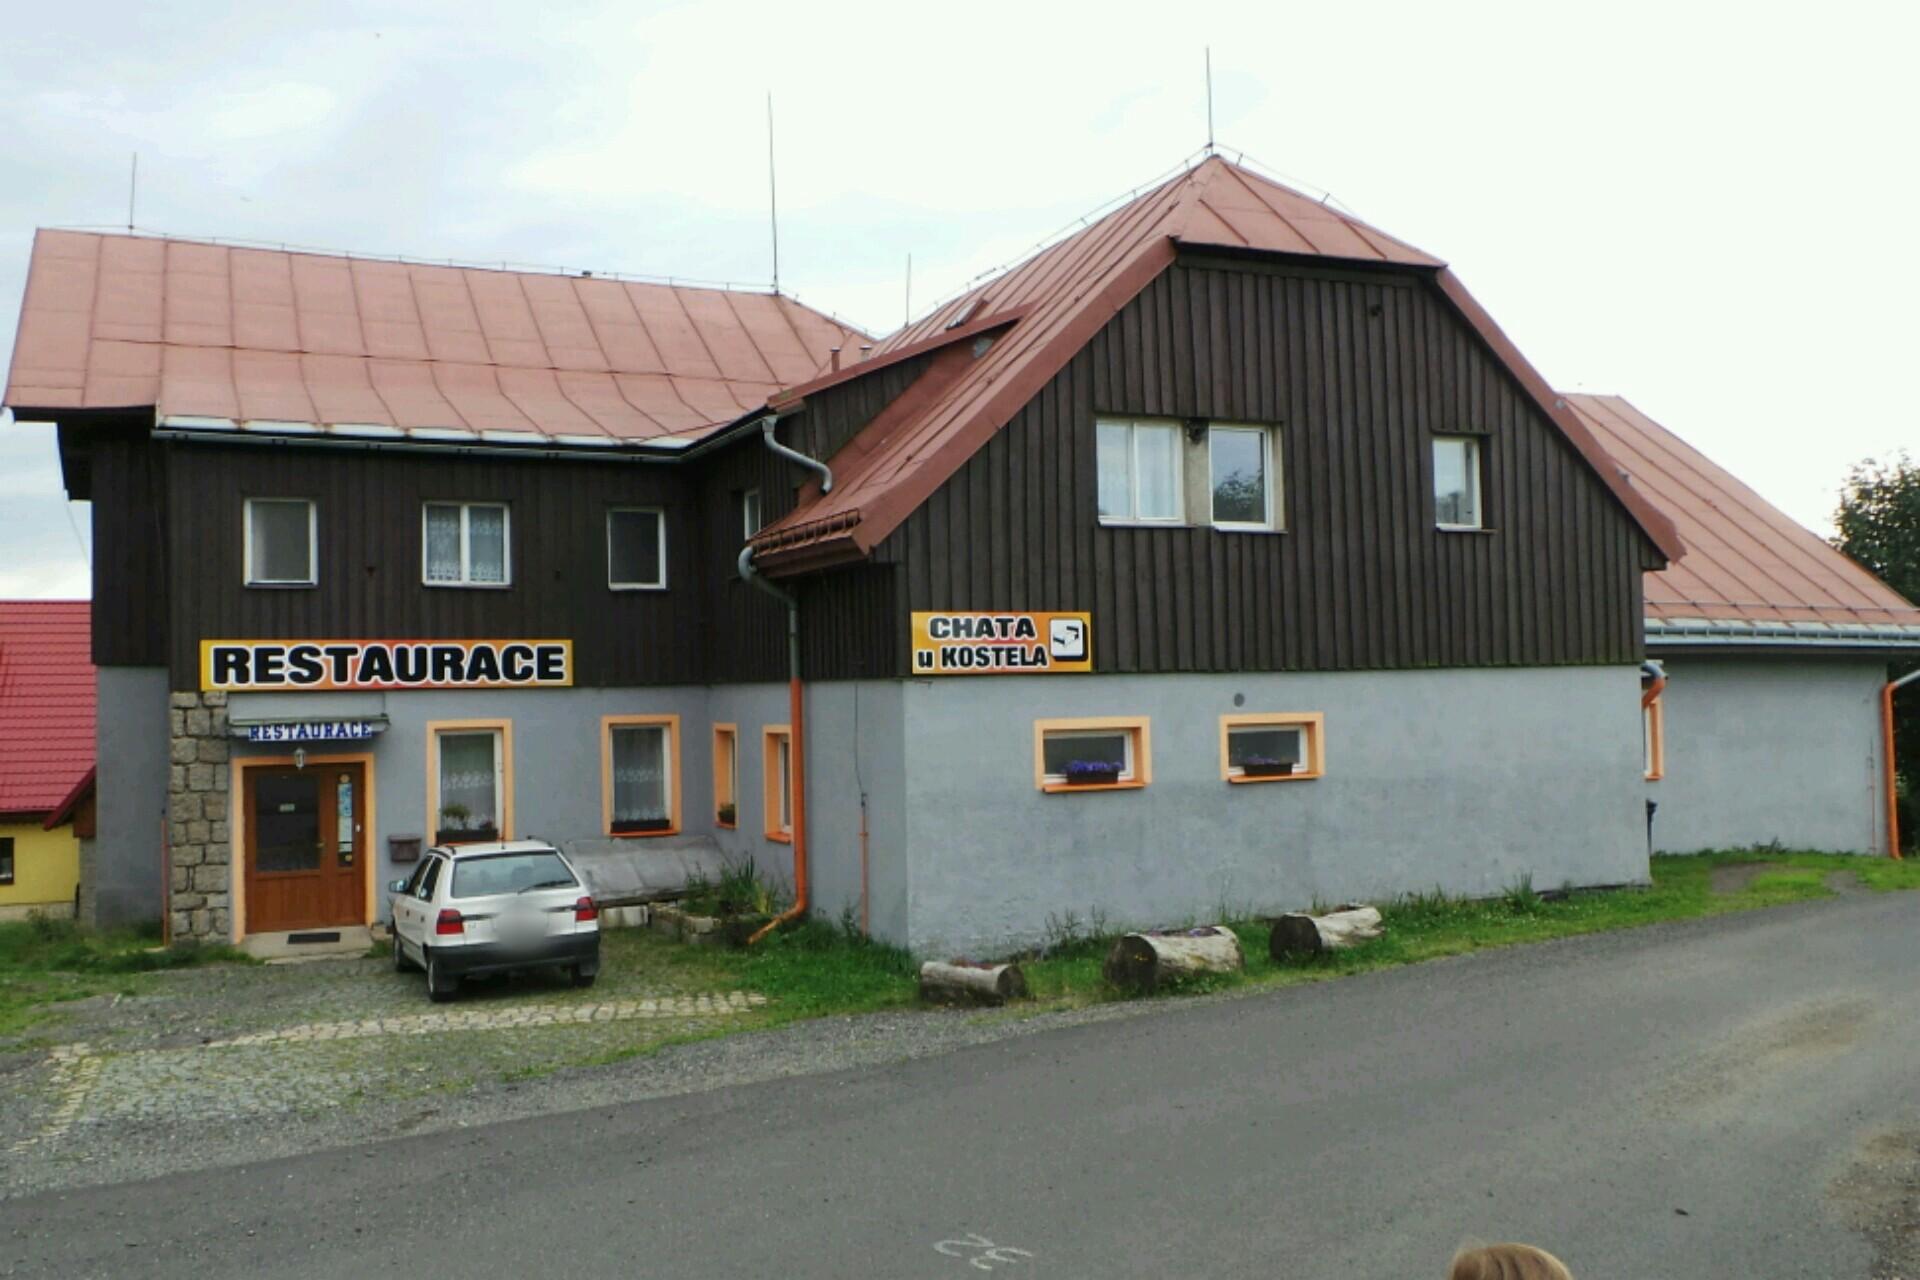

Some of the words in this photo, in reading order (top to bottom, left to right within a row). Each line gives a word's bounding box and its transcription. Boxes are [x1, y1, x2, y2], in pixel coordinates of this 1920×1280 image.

[929, 616, 1037, 639] CHATA
[211, 644, 566, 685] RESTAURACE
[941, 645, 1048, 668] KOSTELA
[248, 721, 373, 740] RESTAURACE
